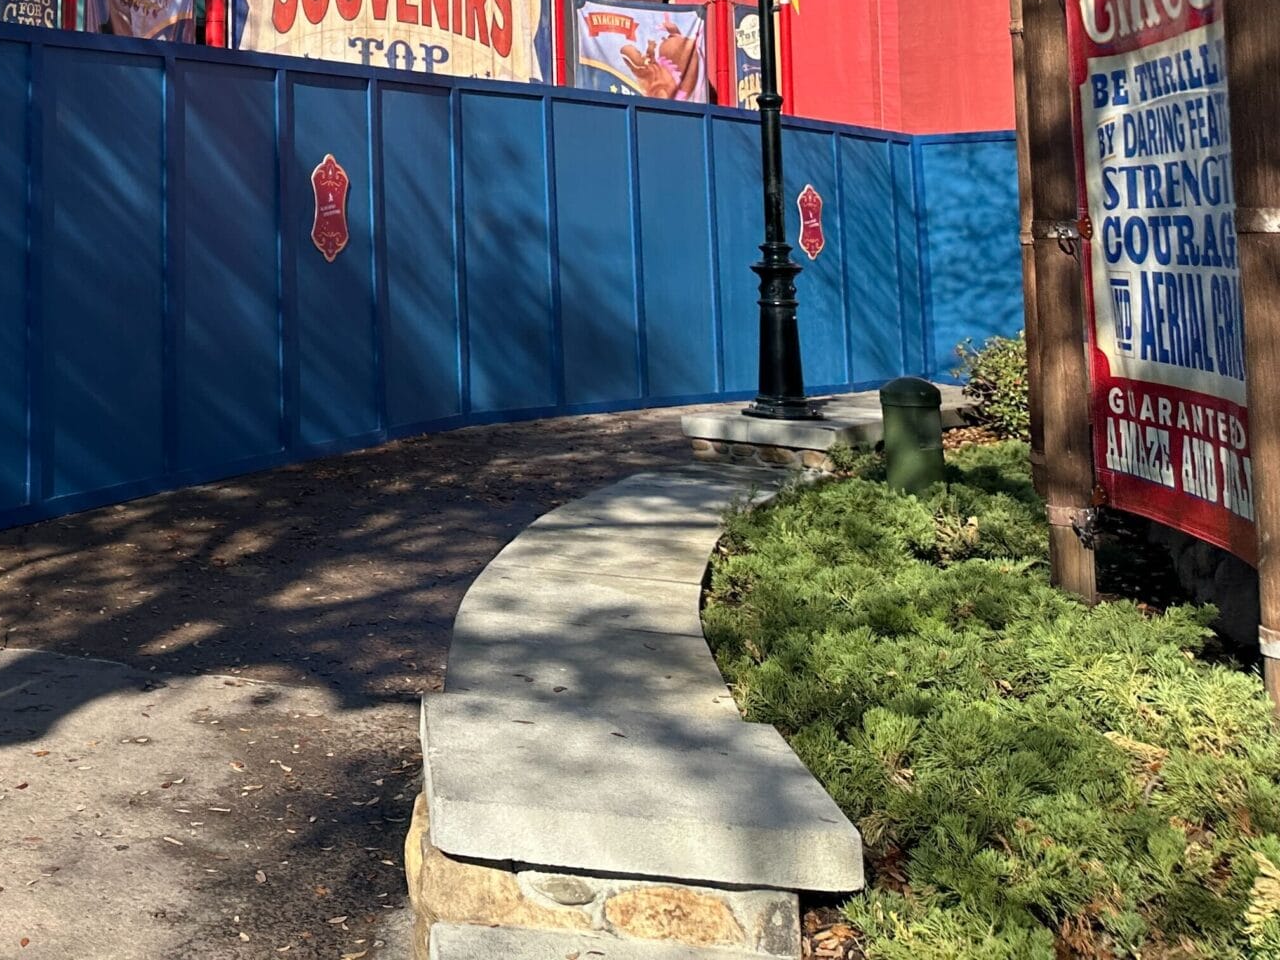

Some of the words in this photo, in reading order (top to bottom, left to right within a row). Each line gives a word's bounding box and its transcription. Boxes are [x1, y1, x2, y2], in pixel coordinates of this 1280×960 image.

[19, 2, 42, 17] FOR
[591, 14, 631, 30] HYACINTH
[348, 36, 450, 75] TOP
[1090, 69, 1129, 109] BE
[1097, 122, 1116, 159] BY
[1122, 103, 1185, 159] DARING
[1184, 92, 1228, 150] FEAT
[1140, 271, 1214, 373] AERIAL
[1106, 417, 1176, 490] AMAZE
[1181, 435, 1218, 504] AND
